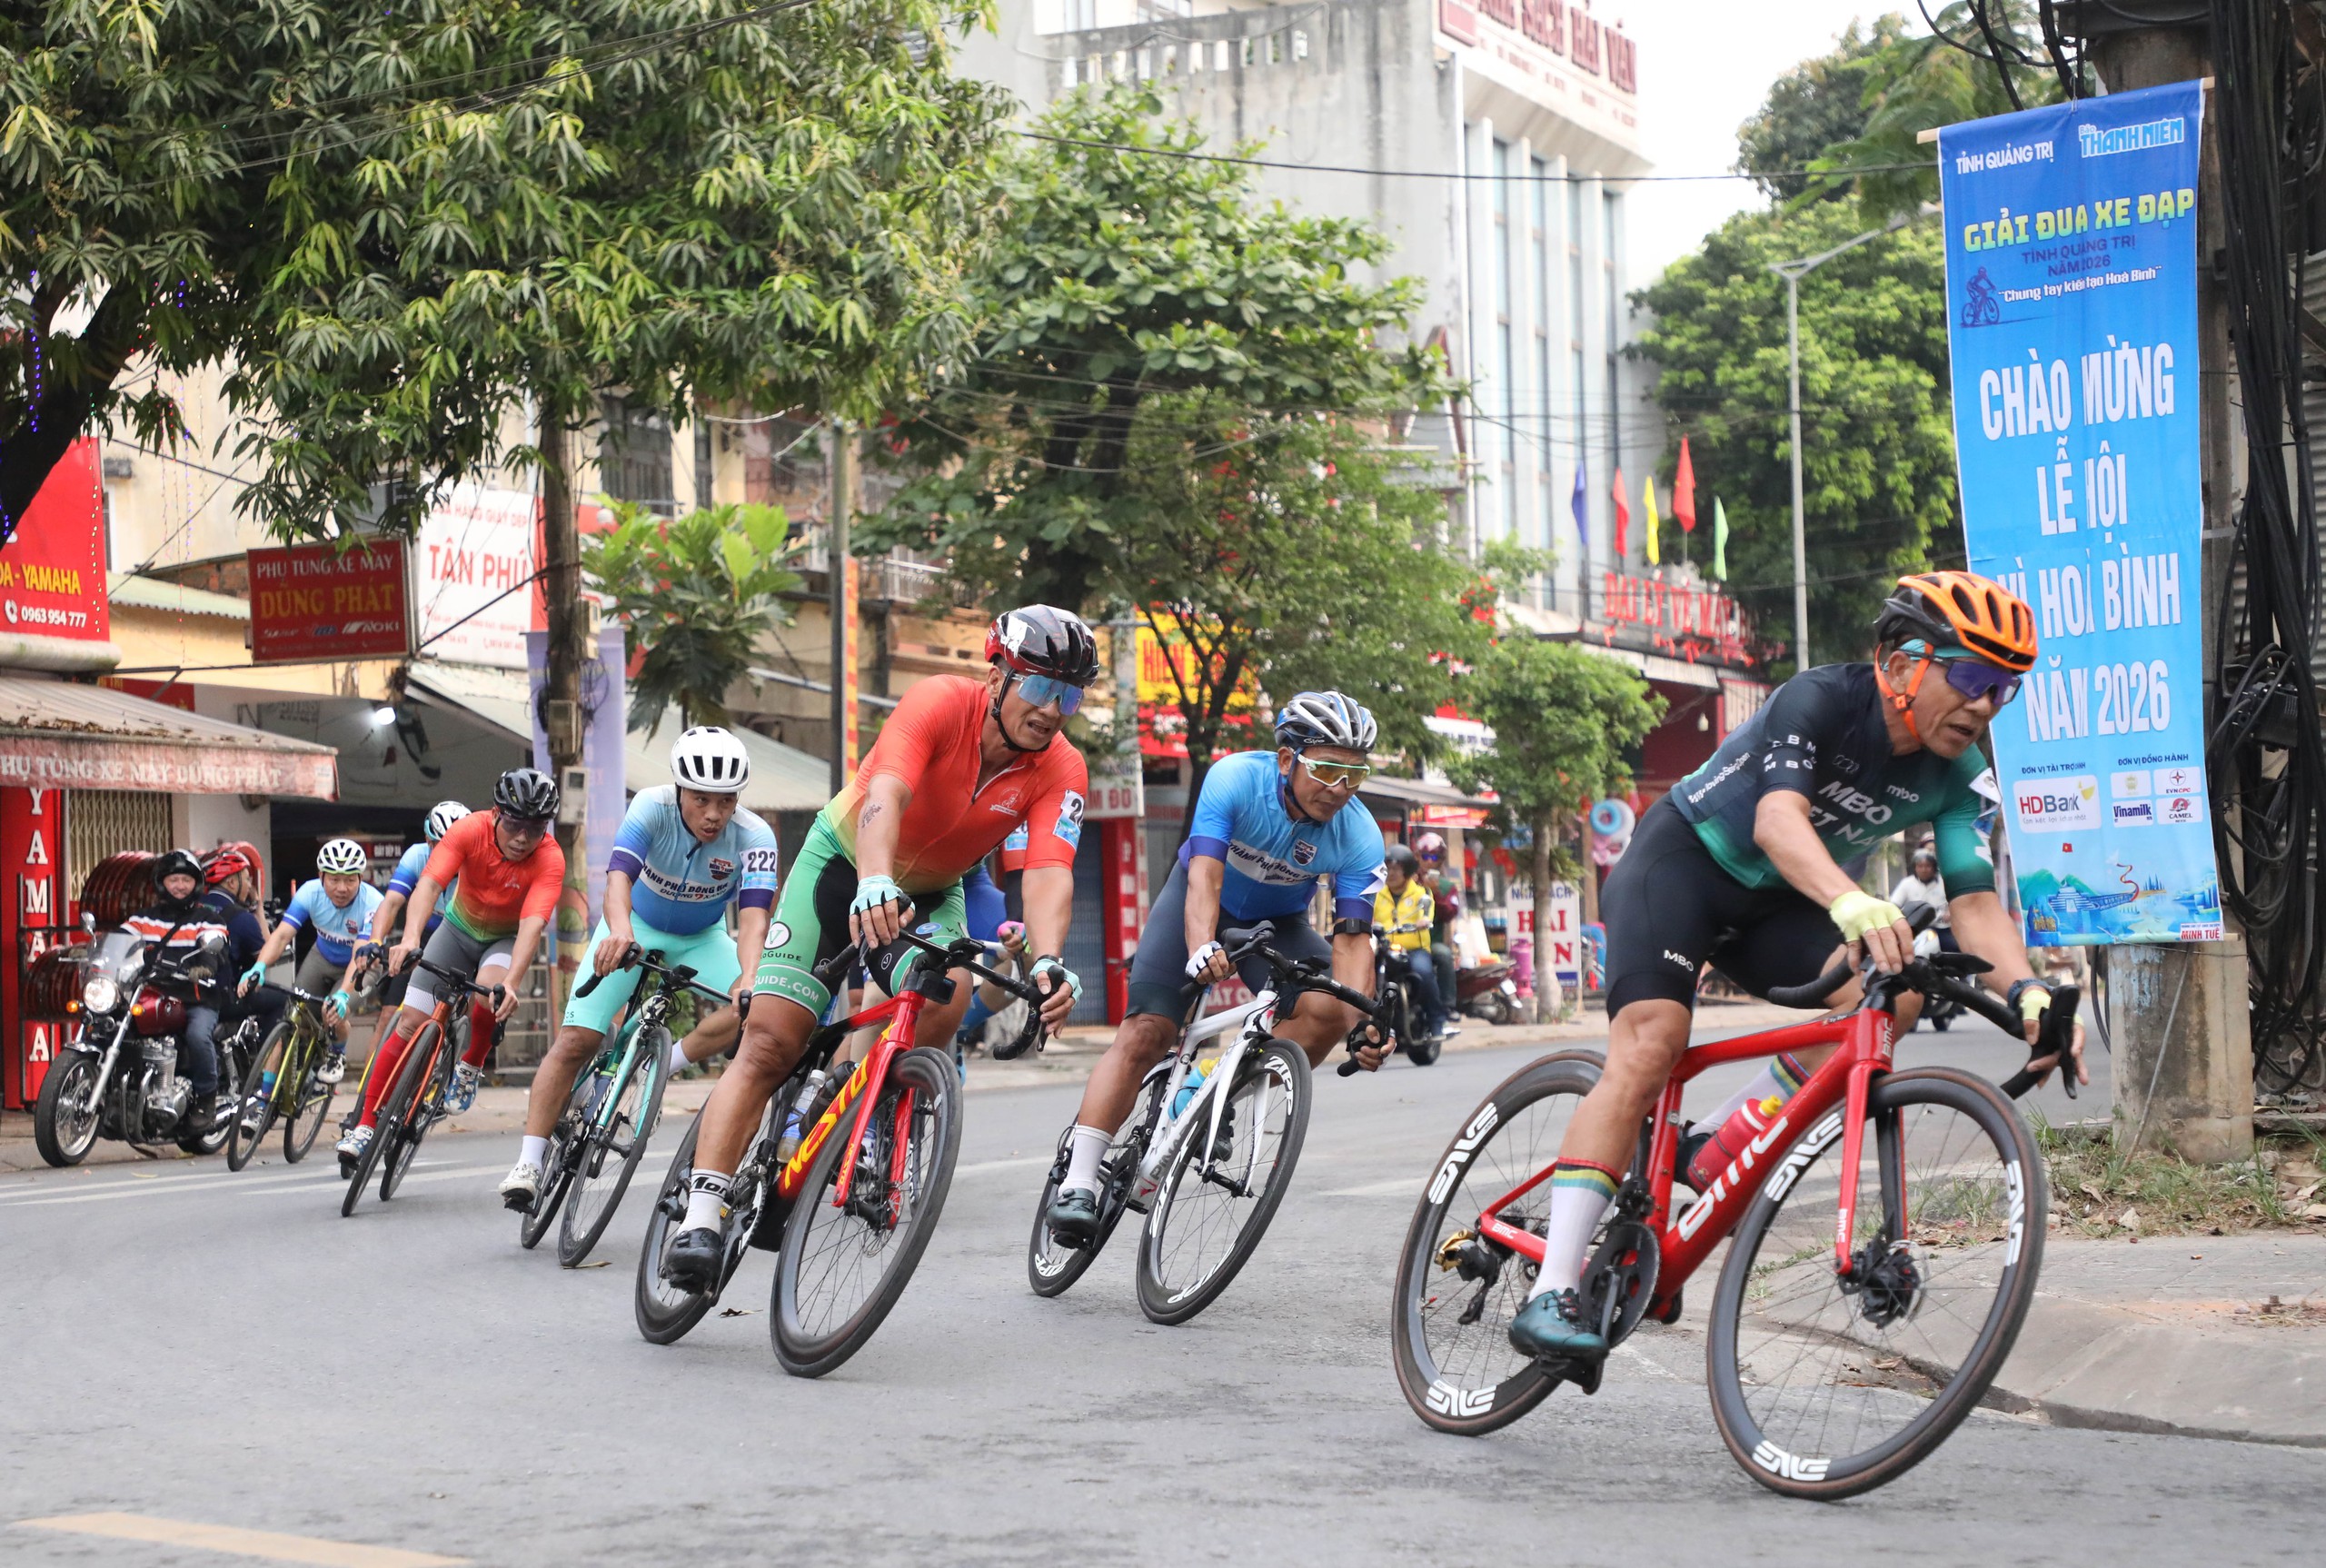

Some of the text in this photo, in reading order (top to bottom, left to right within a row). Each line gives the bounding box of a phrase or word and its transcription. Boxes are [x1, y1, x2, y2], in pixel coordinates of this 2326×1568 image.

[2080, 117, 2184, 158] THANH NIÊN
[1955, 141, 2054, 174] TỈNH QUẢNG TRỊ
[1964, 188, 2195, 253] GIẢI ĐUA XE ĐẠP
[2111, 234, 2136, 251] TRỊ
[2048, 260, 2082, 278] NĂM
[2043, 283, 2063, 297] tay
[2086, 275, 2104, 290] tạo
[2105, 272, 2130, 285] Hoà
[1979, 334, 2176, 442] CHÀO MỪNG
[2036, 434, 2077, 537] LỄ
[256, 561, 287, 582] PHỤ
[337, 556, 355, 574] XE
[429, 537, 528, 593] TÂN PHÚ
[21, 563, 82, 596] YAMAHA
[2102, 542, 2182, 632] BÌNH
[333, 577, 395, 615] PHÁT
[21, 605, 87, 628] 0963 954 777
[2023, 654, 2172, 743] NĂM 2026
[2046, 763, 2059, 772] TÀI
[2164, 752, 2189, 762] HÀNH
[101, 759, 125, 782] XE
[1818, 780, 1893, 825] MBO
[1886, 784, 1920, 803] mbo
[2113, 803, 2152, 818] Vinamilk
[747, 850, 776, 872] 222
[640, 864, 666, 886] HÀNH
[689, 883, 715, 894] ĐÔNG
[25, 787, 50, 1062] YAMAA
[1517, 909, 1566, 933] HI
[2181, 929, 2202, 940] MINH
[1663, 949, 1695, 972] MBO
[784, 1053, 869, 1190] NESTO
[1491, 1222, 1516, 1240] BMC
